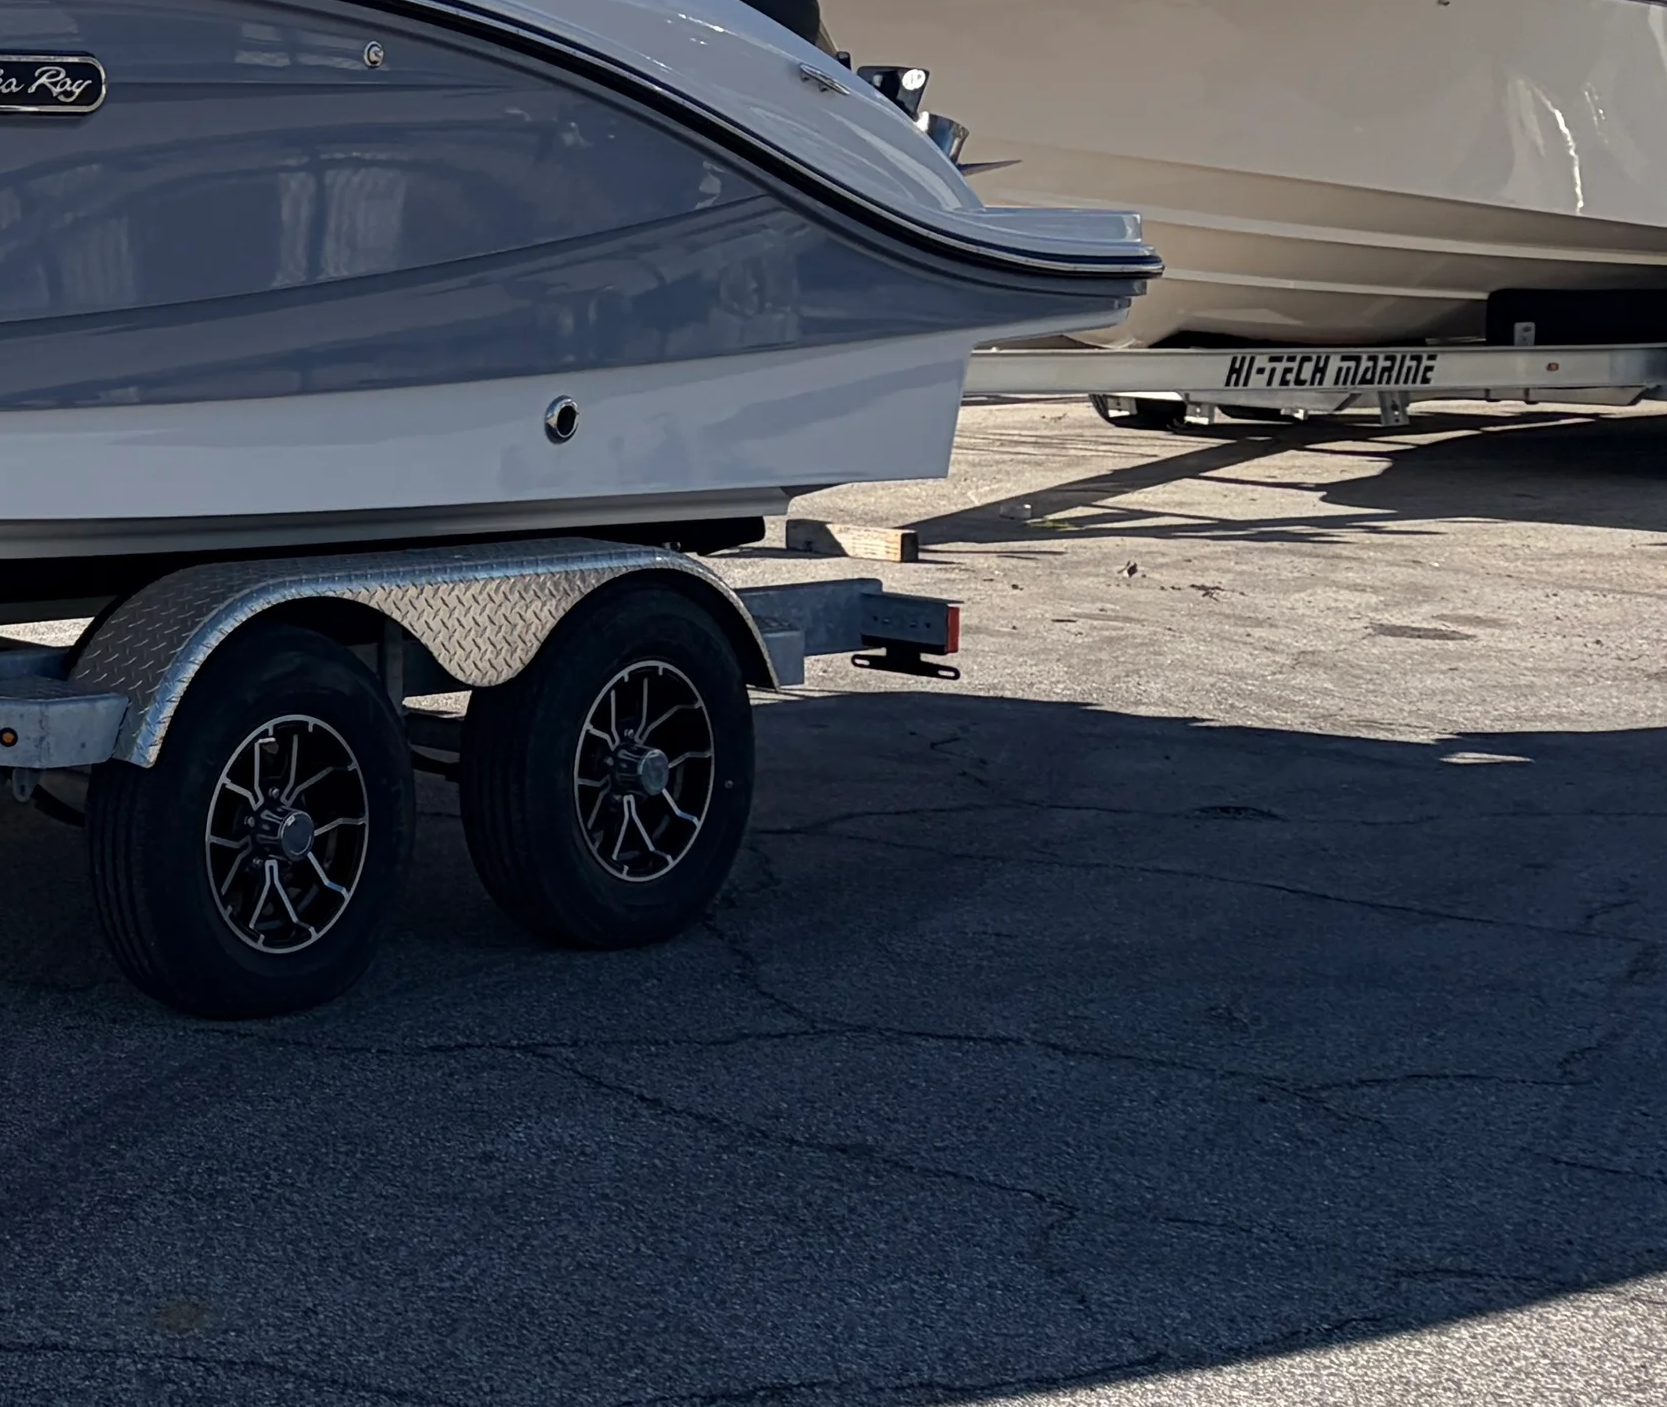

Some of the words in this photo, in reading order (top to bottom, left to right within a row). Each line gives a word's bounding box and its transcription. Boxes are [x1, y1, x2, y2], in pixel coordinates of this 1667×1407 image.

[27, 66, 92, 103] Ray
[1224, 355, 1331, 387] HI-TECH
[1333, 354, 1438, 386] MARINE
